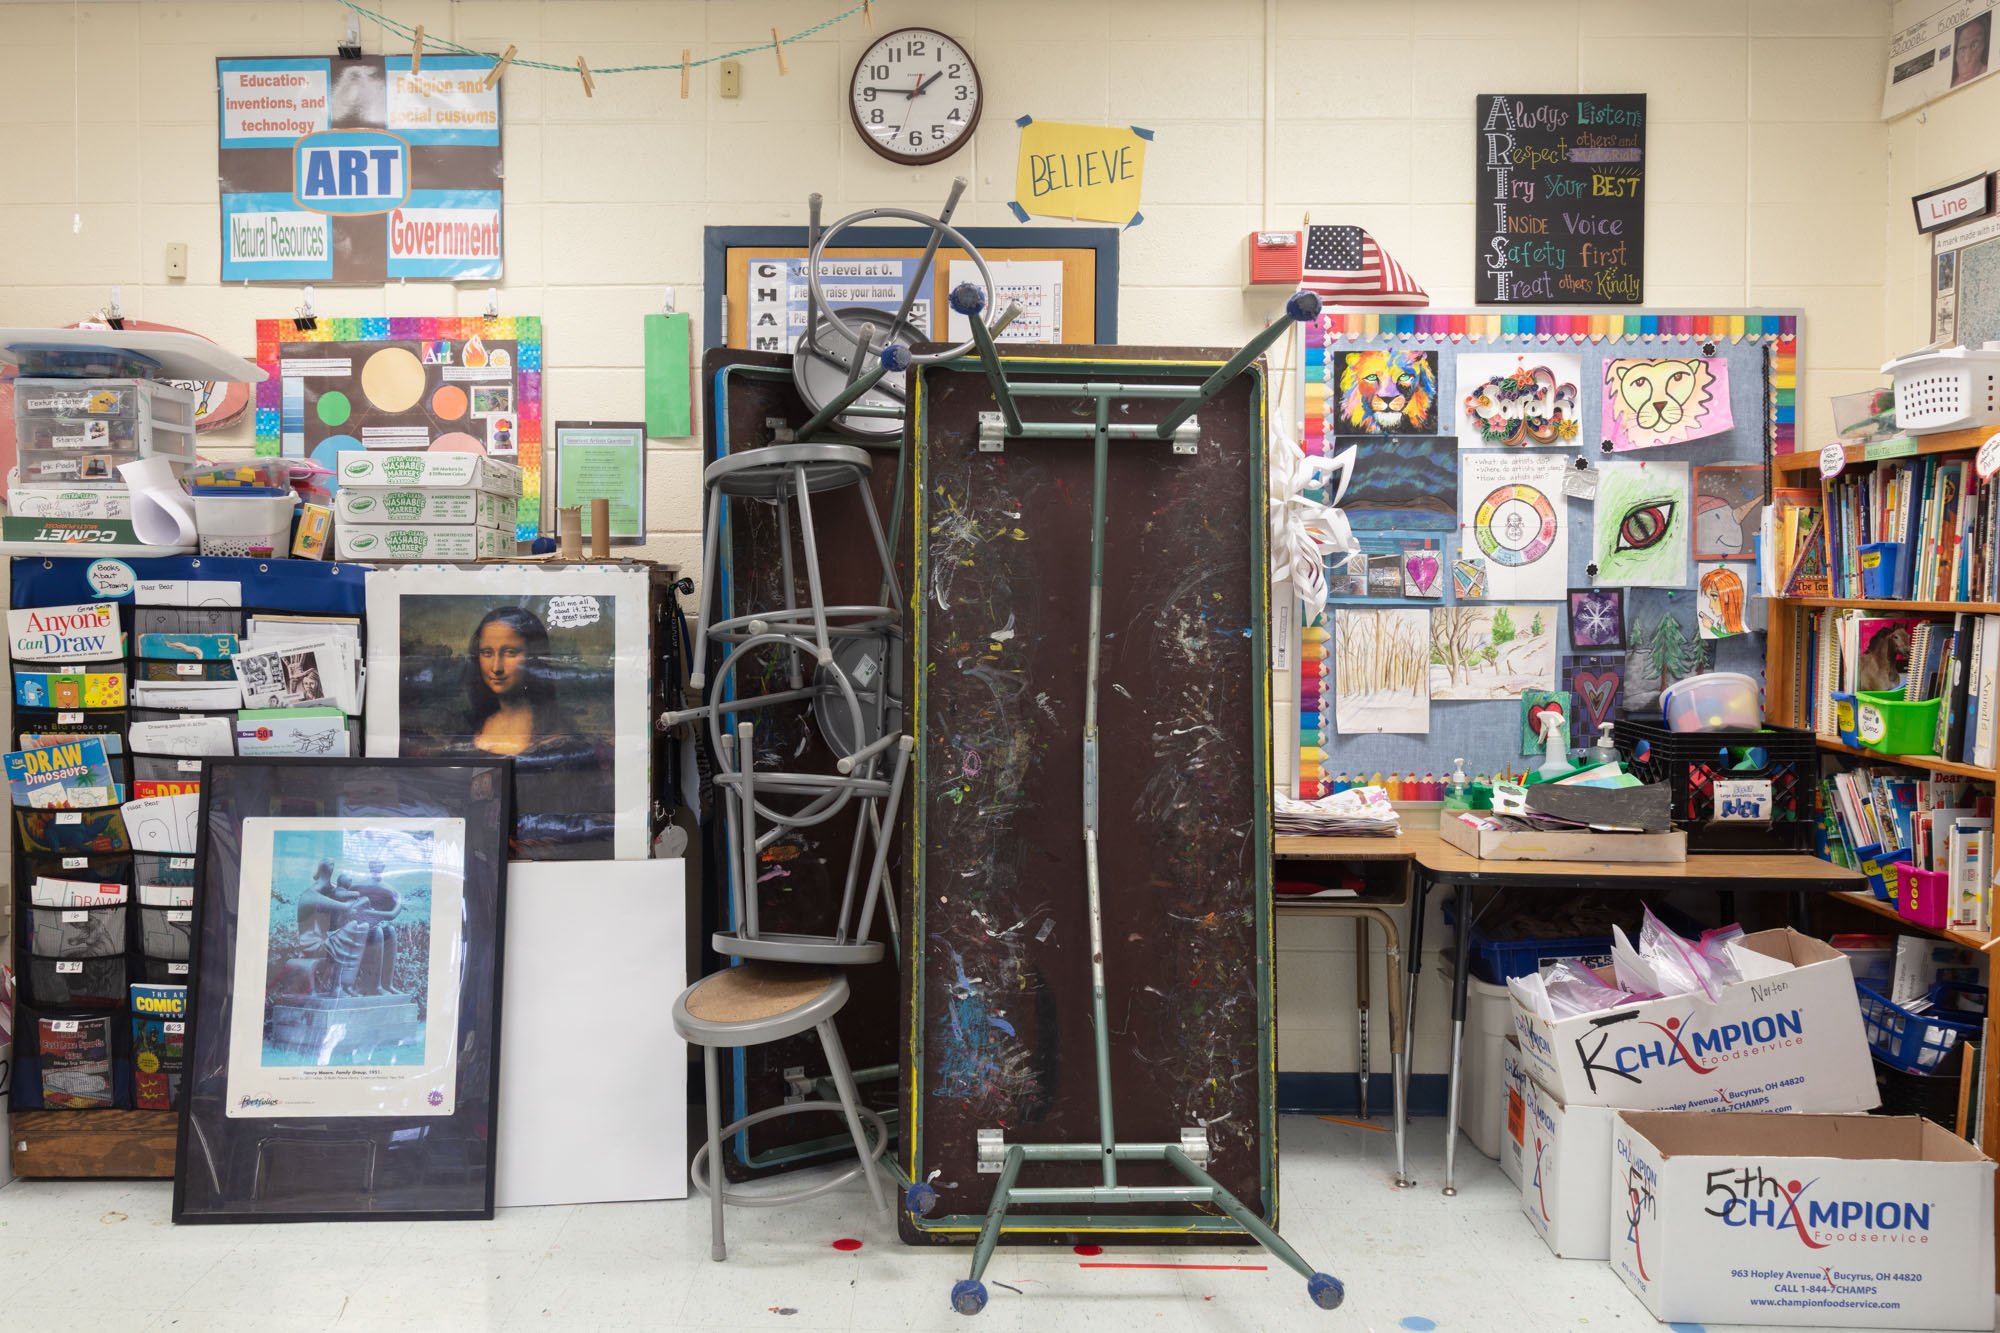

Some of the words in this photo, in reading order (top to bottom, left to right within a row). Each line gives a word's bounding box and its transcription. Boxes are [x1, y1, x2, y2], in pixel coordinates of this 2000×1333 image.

[888, 47, 902, 63] 11
[907, 41, 925, 56] 12
[936, 47, 942, 62] 1
[870, 65, 889, 80] 10
[948, 64, 961, 79] 2
[239, 73, 311, 88] Education,
[396, 75, 453, 98] Religion
[458, 79, 484, 94] and
[863, 86, 877, 102] 9
[954, 85, 968, 101] 3
[225, 96, 298, 111] inventions,
[301, 95, 326, 109] and
[390, 107, 432, 124] social
[436, 109, 497, 124] customs
[870, 108, 884, 124] 8
[947, 107, 961, 122] 4
[1483, 95, 1569, 133] Always
[1577, 101, 1638, 126] Listen
[241, 118, 315, 135] technology
[888, 125, 901, 140] 7
[931, 124, 945, 140] 5
[909, 131, 923, 146] 6
[1576, 131, 1617, 148] others
[1618, 134, 1638, 147] and
[1486, 132, 1568, 170] Respect
[304, 149, 400, 197] ART
[1030, 146, 1135, 198] BELIEVE
[1487, 166, 1536, 204] Try
[1544, 174, 1588, 200] Your
[1592, 174, 1641, 198] BEST
[1931, 197, 1968, 220] Line
[1562, 212, 1624, 236] Voice
[232, 216, 268, 258] Natural
[271, 215, 324, 257] Resources
[390, 208, 499, 257] Government
[1943, 234, 1959, 247] mark
[1959, 228, 1976, 243] made
[1977, 224, 1991, 239] with
[1484, 235, 1566, 270] Safety
[1579, 240, 1628, 268] first
[831, 263, 862, 277] level
[865, 264, 878, 277] at
[826, 287, 848, 299] raise
[849, 288, 875, 302] your
[876, 285, 897, 299] hand.
[1487, 270, 1554, 301] Treat
[1558, 274, 1593, 293] others
[1594, 270, 1641, 301] Kindly
[423, 346, 455, 365] Art
[55, 436, 84, 444] Stamps
[55, 462, 75, 470] Pads
[382, 461, 426, 472] WASHABLE
[387, 469, 421, 479] MARKERS
[383, 497, 427, 508] WASHABLE
[387, 506, 421, 515] MARKERS
[34, 529, 118, 543] COMET
[385, 535, 428, 546] WASHABLE
[389, 544, 423, 553] MARKERS
[97, 564, 121, 572] Books
[99, 580, 129, 591] Drawing
[551, 600, 566, 608] Tell
[26, 611, 111, 637] Anyone
[562, 613, 578, 621] great
[17, 637, 43, 651] Can
[43, 633, 106, 655] Draw
[70, 714, 77, 722] 4
[257, 730, 268, 738] 50
[23, 743, 83, 775] DRAW
[24, 765, 89, 786] Dinosaurs
[64, 813, 73, 821] 10
[1751, 981, 1789, 1003] Norton
[136, 996, 182, 1013] COMIC
[171, 1024, 182, 1032] 23
[1615, 1009, 1804, 1074] CHAMPION
[1701, 1036, 1804, 1067] Foodservice
[1687, 1096, 1719, 1109] Avenue
[1728, 1086, 1764, 1100] Bucyrus,
[1764, 1081, 1779, 1092] OH
[1779, 1075, 1805, 1088] 44820
[1626, 1165, 1657, 1227] 5th
[1704, 1165, 1779, 1218] 5th
[1722, 1187, 1931, 1240] CHAMPION
[1814, 1230, 1930, 1244] Foodservice
[1731, 1269, 1748, 1279] 963
[1750, 1269, 1785, 1282] Hopley
[1786, 1269, 1822, 1281] Avenue
[1833, 1270, 1874, 1283] Bucyrus,
[1876, 1271, 1891, 1282] OH
[1892, 1272, 1923, 1283] 44820
[1774, 1284, 1799, 1295] CALL
[1800, 1284, 1878, 1296] 1-844-7CHAMPS
[1750, 1298, 1901, 1311] www.championfoodservice.com
